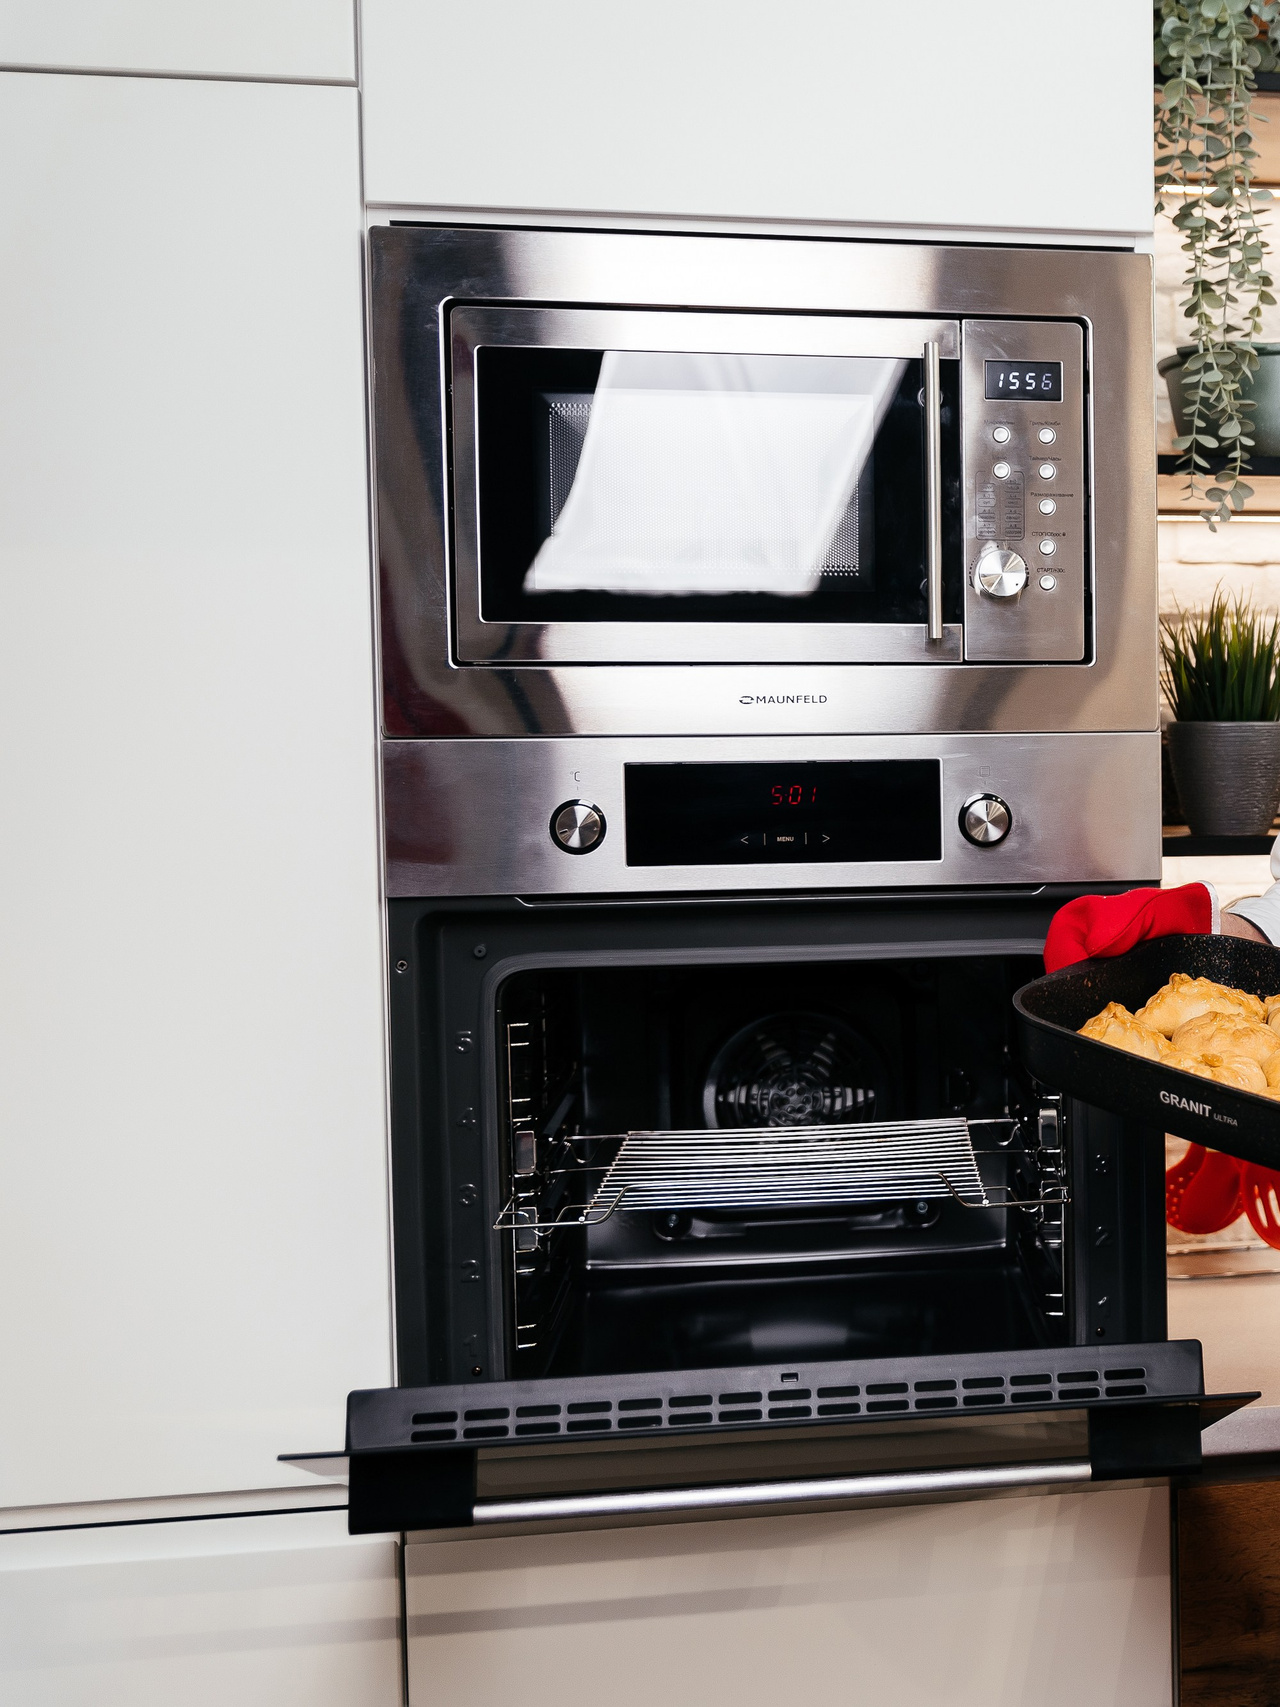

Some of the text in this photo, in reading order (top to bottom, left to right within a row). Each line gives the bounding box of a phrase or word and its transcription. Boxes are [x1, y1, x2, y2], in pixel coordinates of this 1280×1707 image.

[756, 694, 828, 704] MAUNFELD
[455, 1031, 474, 1054] 5
[1159, 1090, 1238, 1126] GRANIT ULTRA
